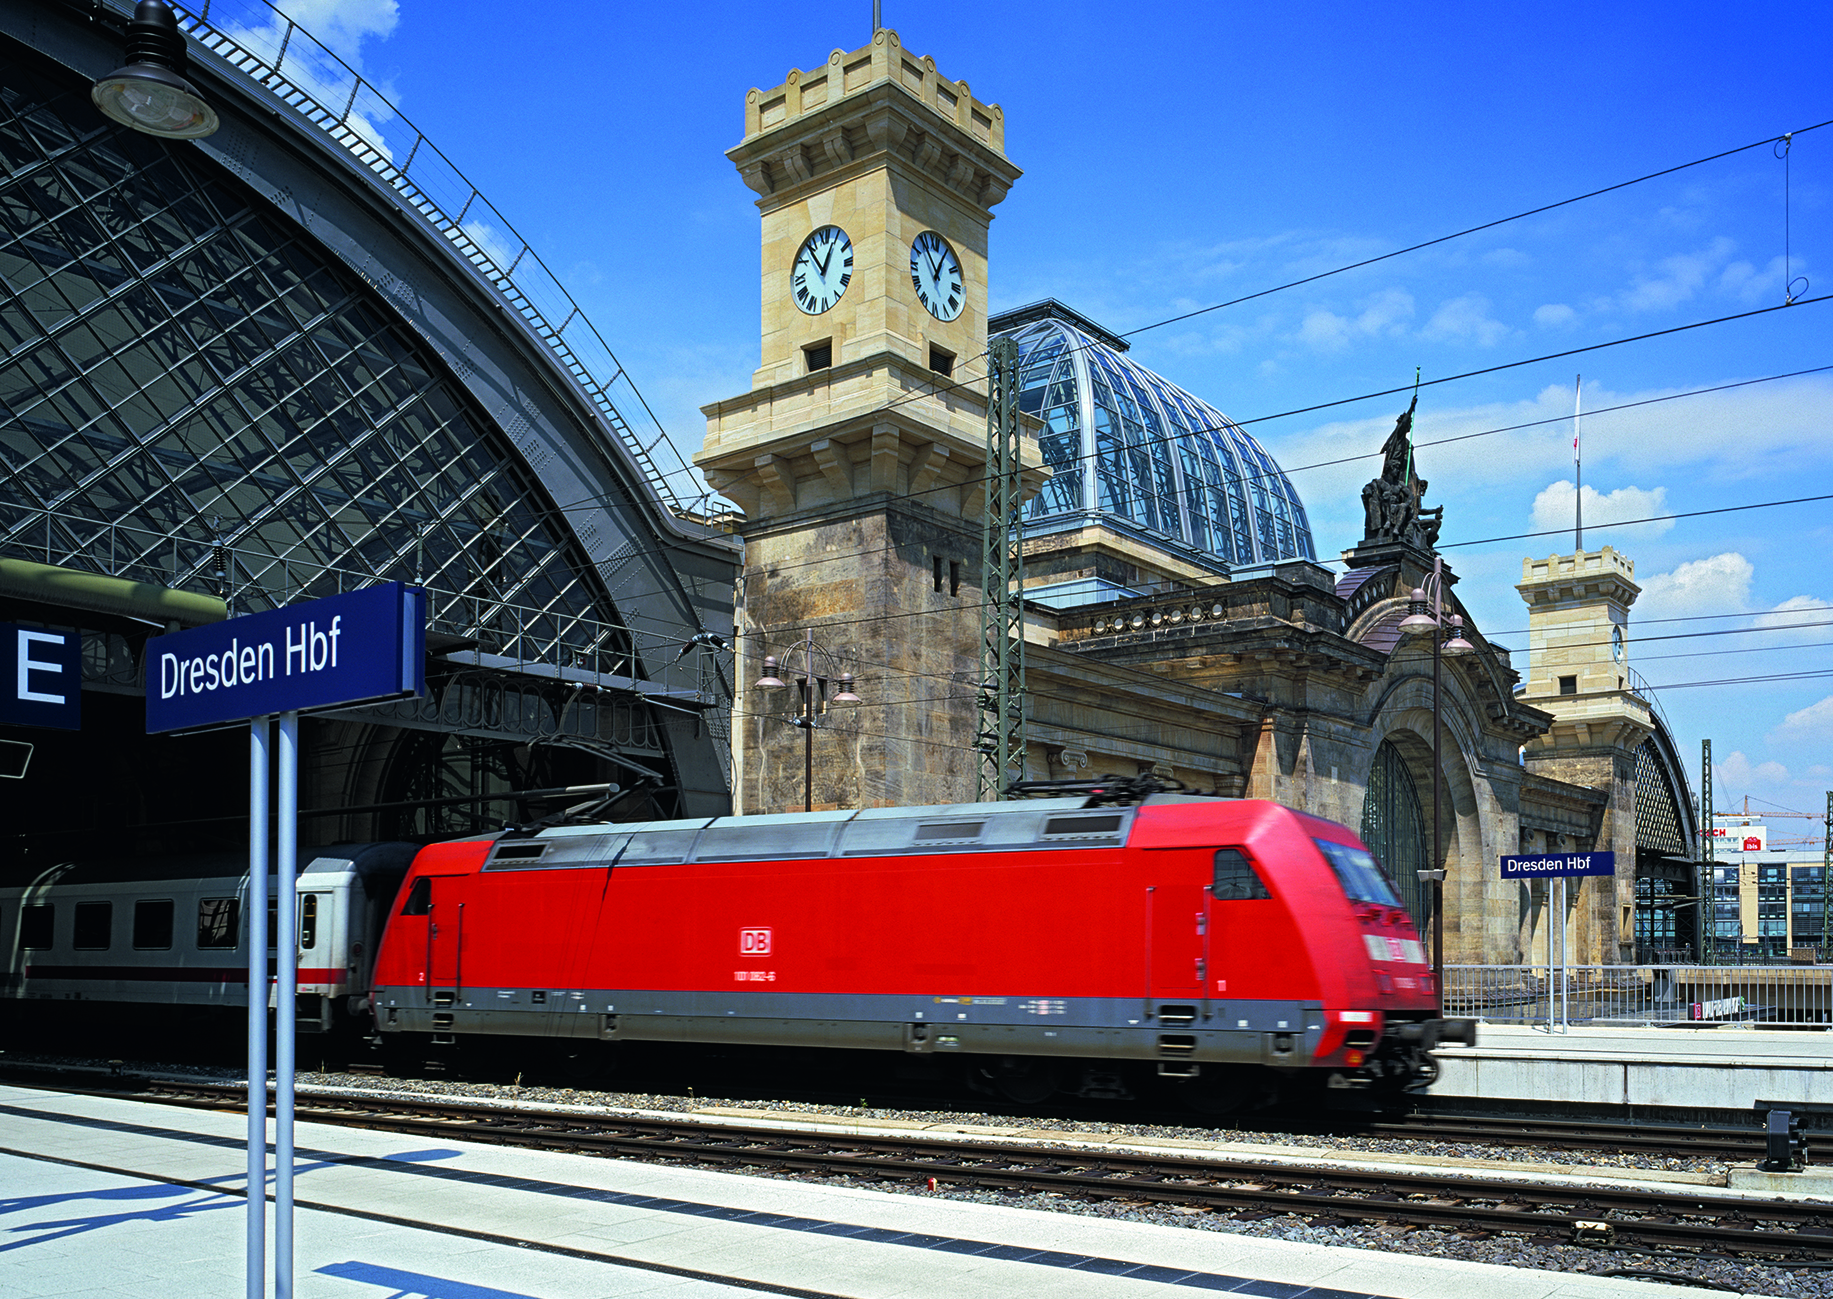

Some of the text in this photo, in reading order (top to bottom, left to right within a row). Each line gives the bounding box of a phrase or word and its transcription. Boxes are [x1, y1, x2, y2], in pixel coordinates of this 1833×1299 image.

[17, 629, 66, 705] E
[161, 615, 342, 700] Dresden Hbf
[1507, 856, 1591, 872] Dresden Hbf
[742, 930, 769, 953] DB
